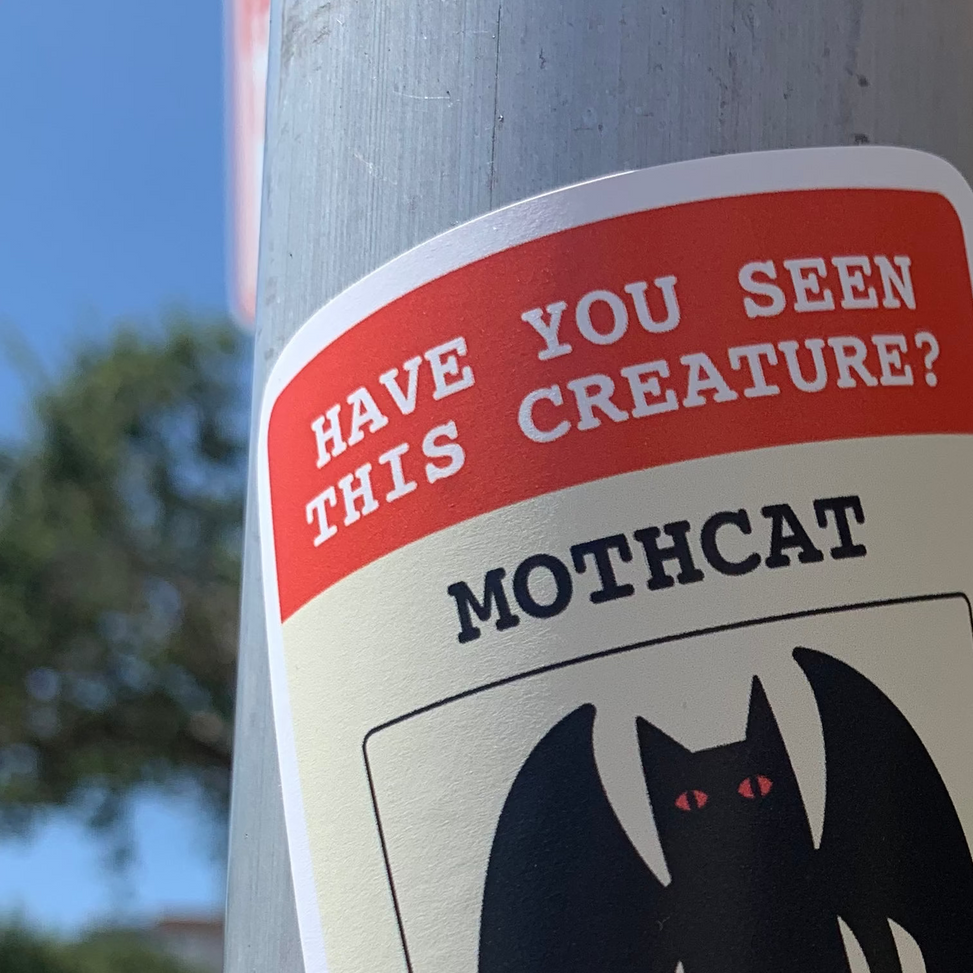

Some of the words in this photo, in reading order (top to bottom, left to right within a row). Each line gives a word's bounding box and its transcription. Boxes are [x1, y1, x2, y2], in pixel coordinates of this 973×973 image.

[306, 422, 466, 547] THIS
[517, 332, 940, 443] CREATURE?
[311, 337, 475, 469] HAVE
[521, 275, 682, 361] YOU
[739, 255, 917, 319] SEEN
[447, 496, 867, 643] MOTHCAT
